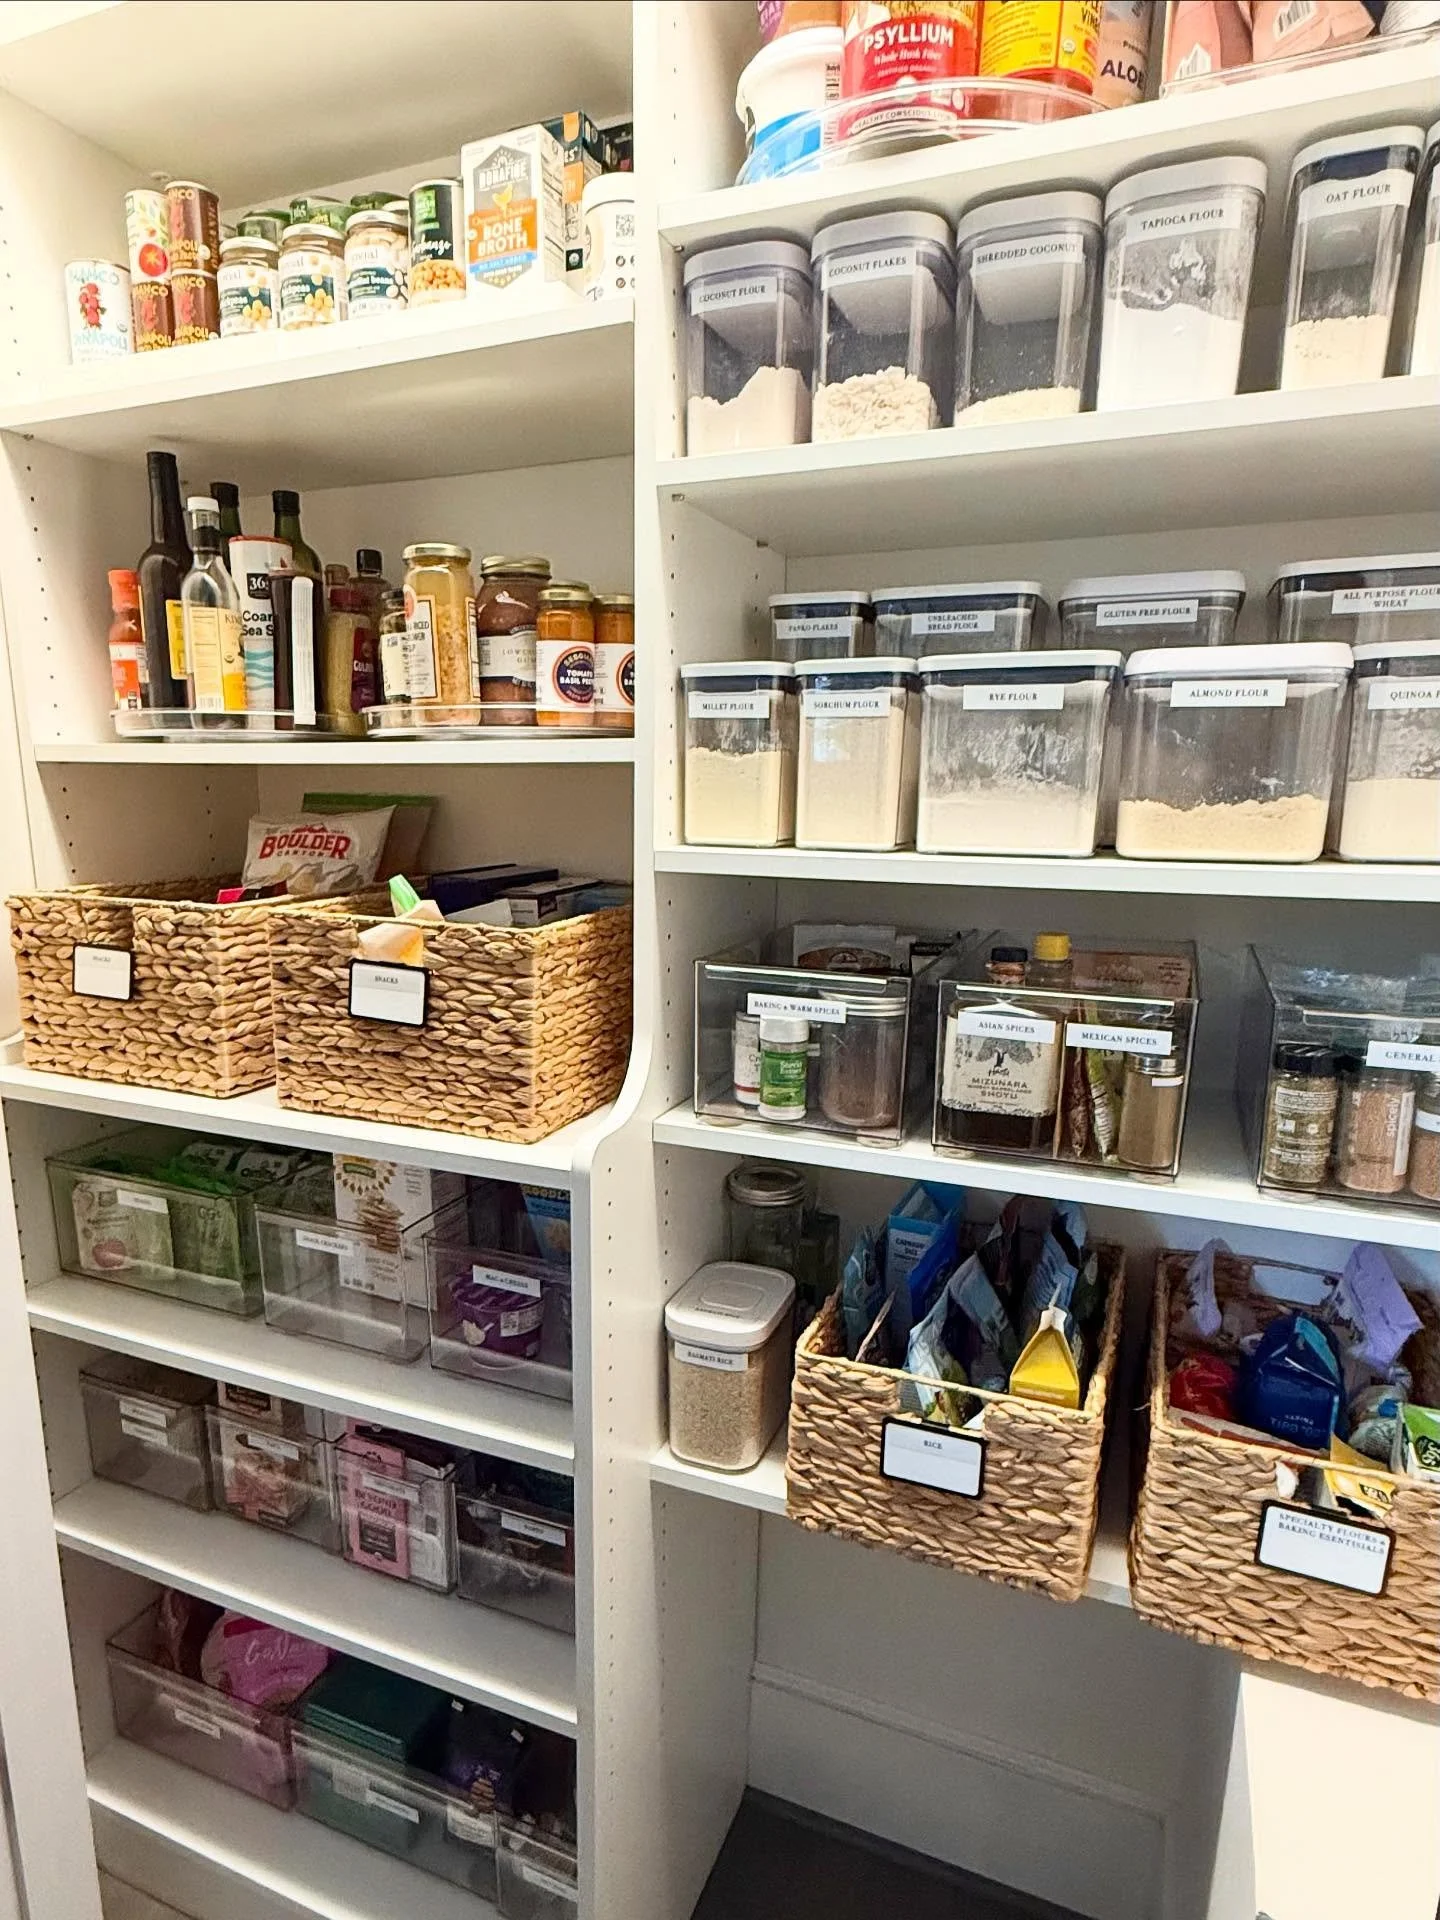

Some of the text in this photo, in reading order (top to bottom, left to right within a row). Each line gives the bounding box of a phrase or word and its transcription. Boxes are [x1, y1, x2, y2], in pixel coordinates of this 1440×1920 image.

[864, 22, 954, 54] PSYLLIUM
[898, 48, 921, 60] Husk
[1326, 184, 1391, 204] OAT FLOUR
[1141, 208, 1224, 231] TAPIOCA FLOUR
[483, 216, 524, 240] BONE
[477, 231, 528, 256] BROTH
[977, 243, 1078, 264] SHREDDED COCONUT
[828, 256, 907, 278] COCONUT FLAKES
[698, 284, 767, 303] COCONUT FLOUR
[1343, 592, 1361, 600] ALL
[1364, 588, 1406, 599] PURPOSE
[1374, 600, 1408, 608] WHEAT
[243, 610, 274, 622] Coar
[928, 614, 978, 622] UNBLEACHED
[1104, 607, 1191, 619] GLUTEN FREE FLOUR
[242, 625, 262, 636] Sea
[789, 623, 838, 632] PANKO FLAKES
[928, 622, 978, 631] BREAD FLOUR
[559, 677, 581, 686] BASIL
[989, 692, 1038, 701] RYE FLOUR
[1190, 687, 1269, 698] ALMOND FLOUR
[1390, 688, 1432, 700] QUINOA
[702, 703, 754, 711] MILLET FLOUR
[813, 700, 880, 710] SORGHUM FLOUR
[259, 832, 352, 860] BOULDER
[276, 849, 324, 858] CANYON
[375, 975, 399, 985] SNACKS
[754, 1001, 781, 1010] BAKING
[789, 1003, 813, 1013] WARM
[814, 1006, 840, 1016] SPICES
[978, 1021, 1036, 1034] ASIAN SPICES
[1082, 1031, 1157, 1046] MEXICAN SPICES
[1385, 1050, 1436, 1063] GENERAL
[972, 1077, 1028, 1089] MIZUNARA
[981, 1090, 1018, 1100] SHOYU
[1386, 1098, 1401, 1137] spicely
[687, 1351, 733, 1366] BASMATI RICE
[923, 1439, 943, 1450] RICE
[1278, 1522, 1316, 1538] BAKING
[1279, 1512, 1333, 1532] SPECIALTY
[1336, 1527, 1378, 1544] FLOURS
